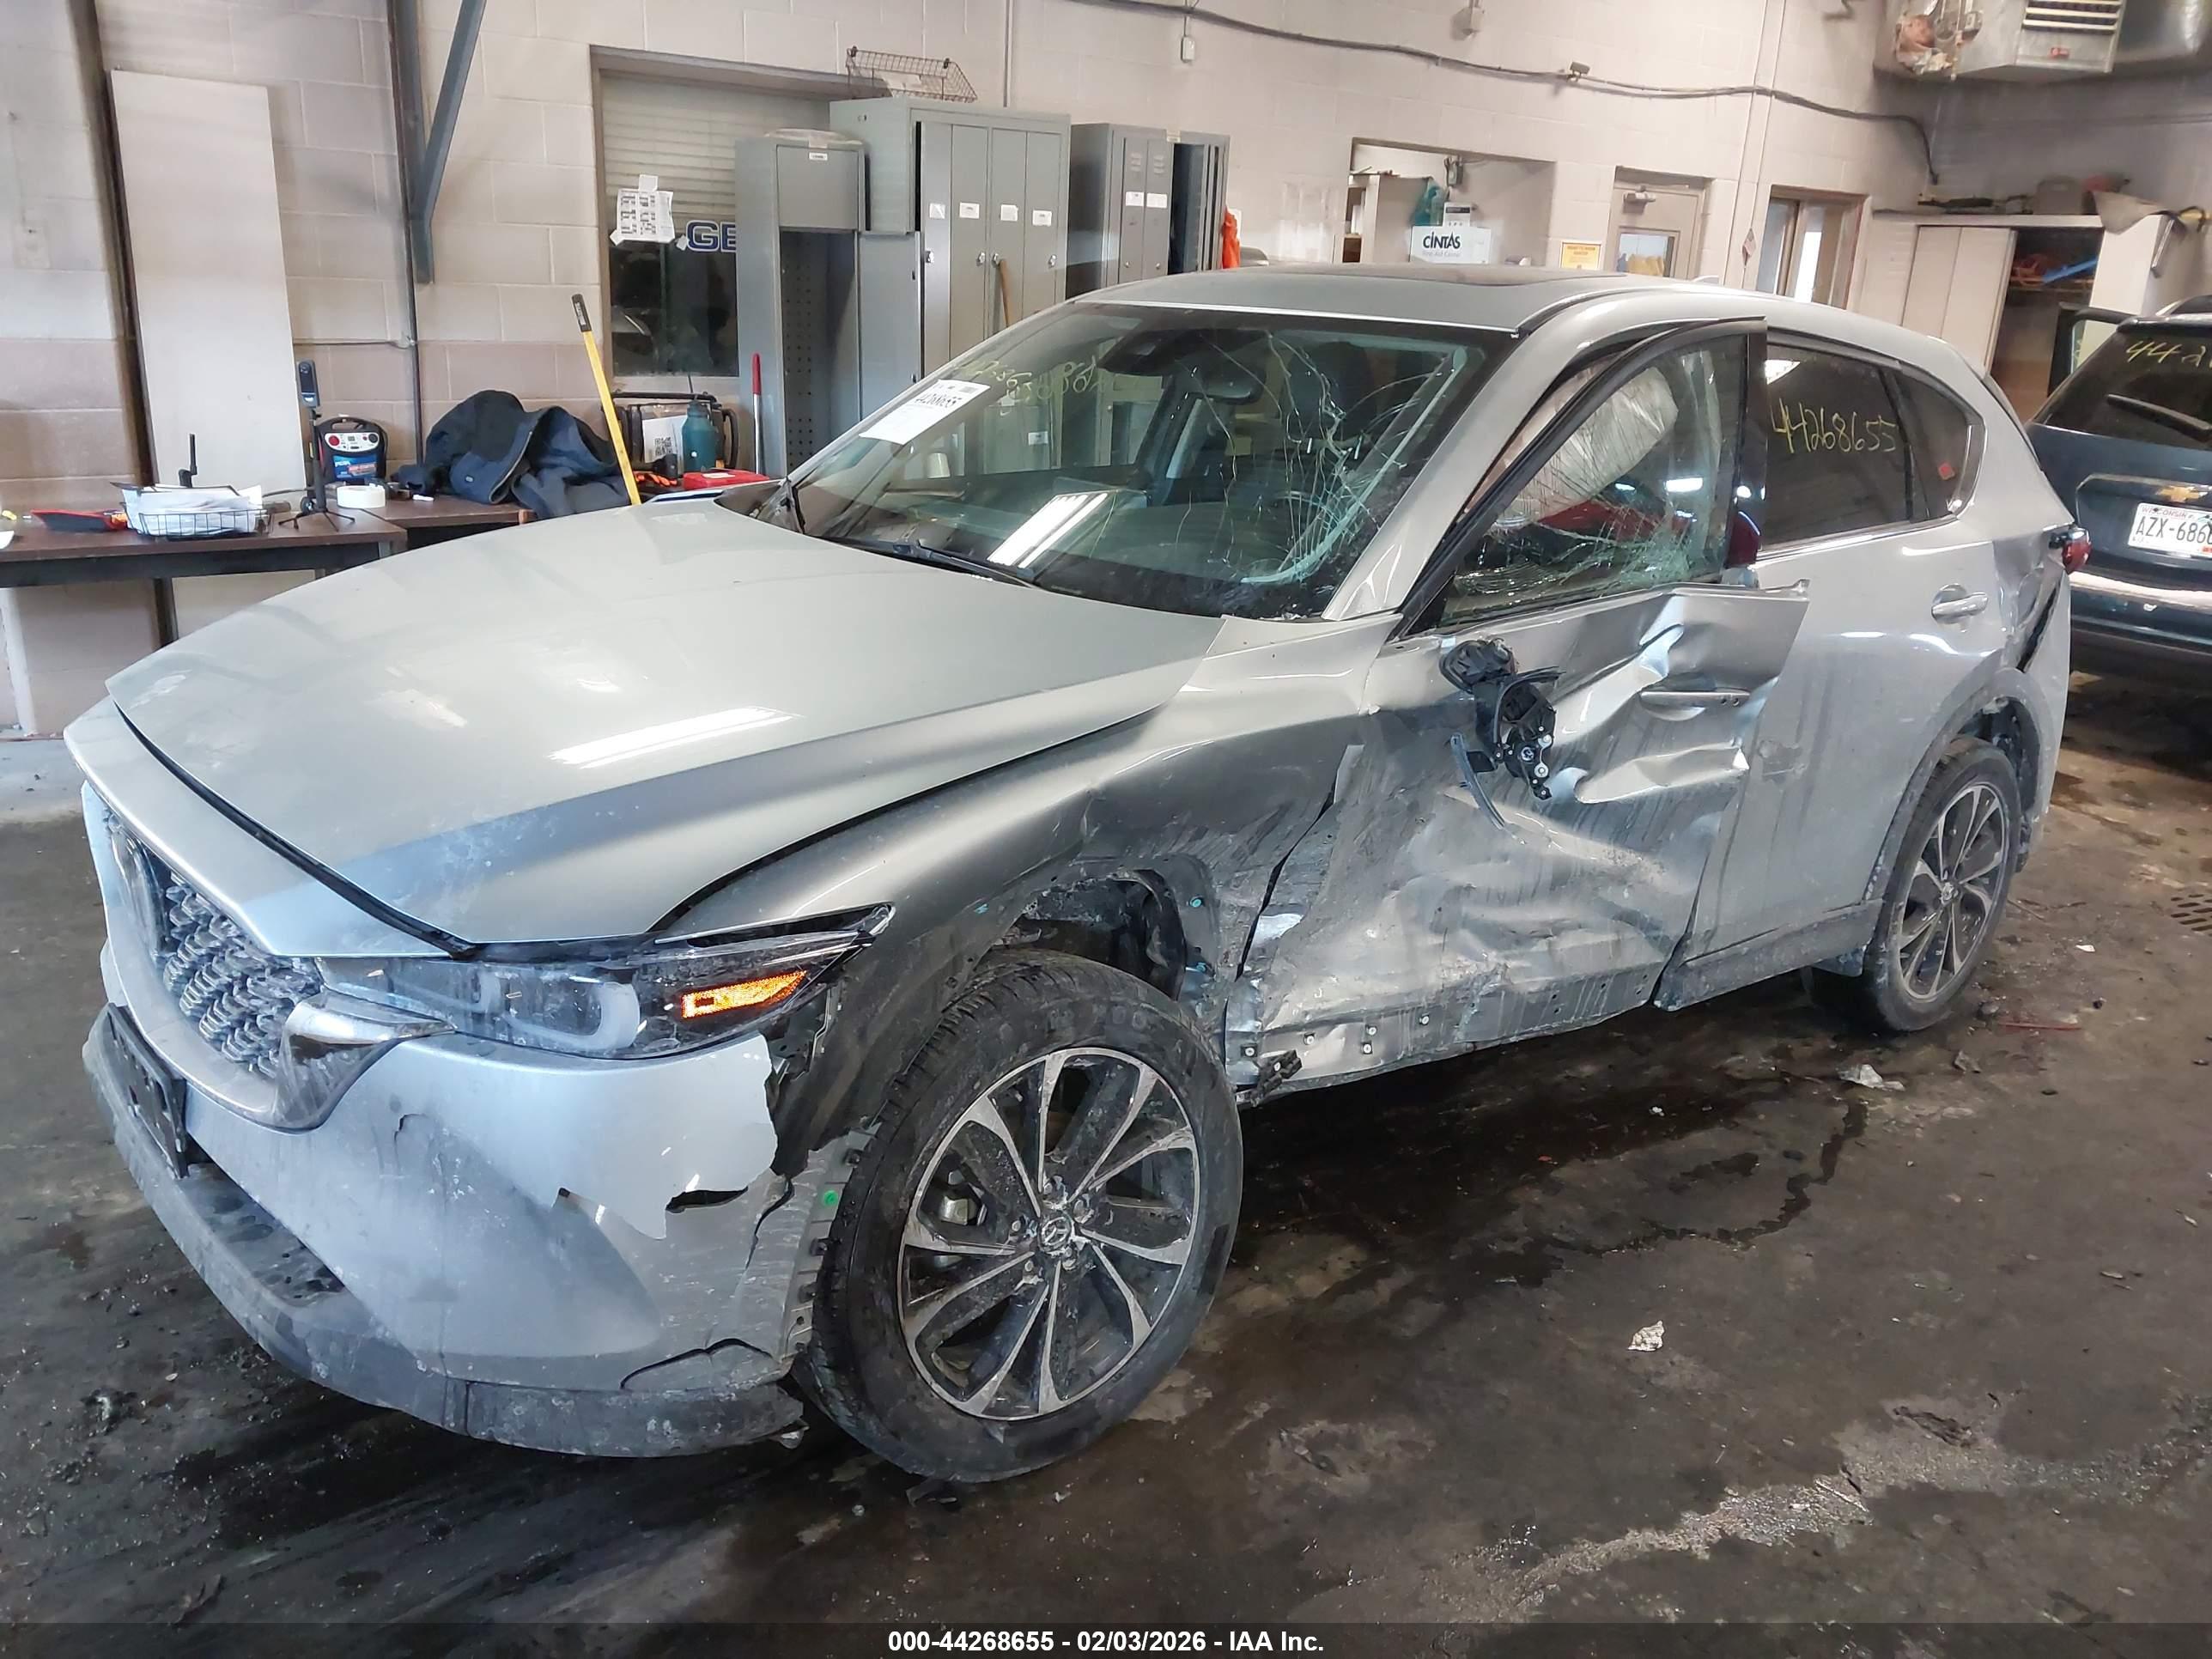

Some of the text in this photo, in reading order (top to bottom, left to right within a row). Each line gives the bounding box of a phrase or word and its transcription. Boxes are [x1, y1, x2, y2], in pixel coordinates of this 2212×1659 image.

[1423, 231, 1461, 249] CINTAS
[1770, 398, 1897, 453] 44268655
[2142, 507, 2186, 519] WISCONSIN
